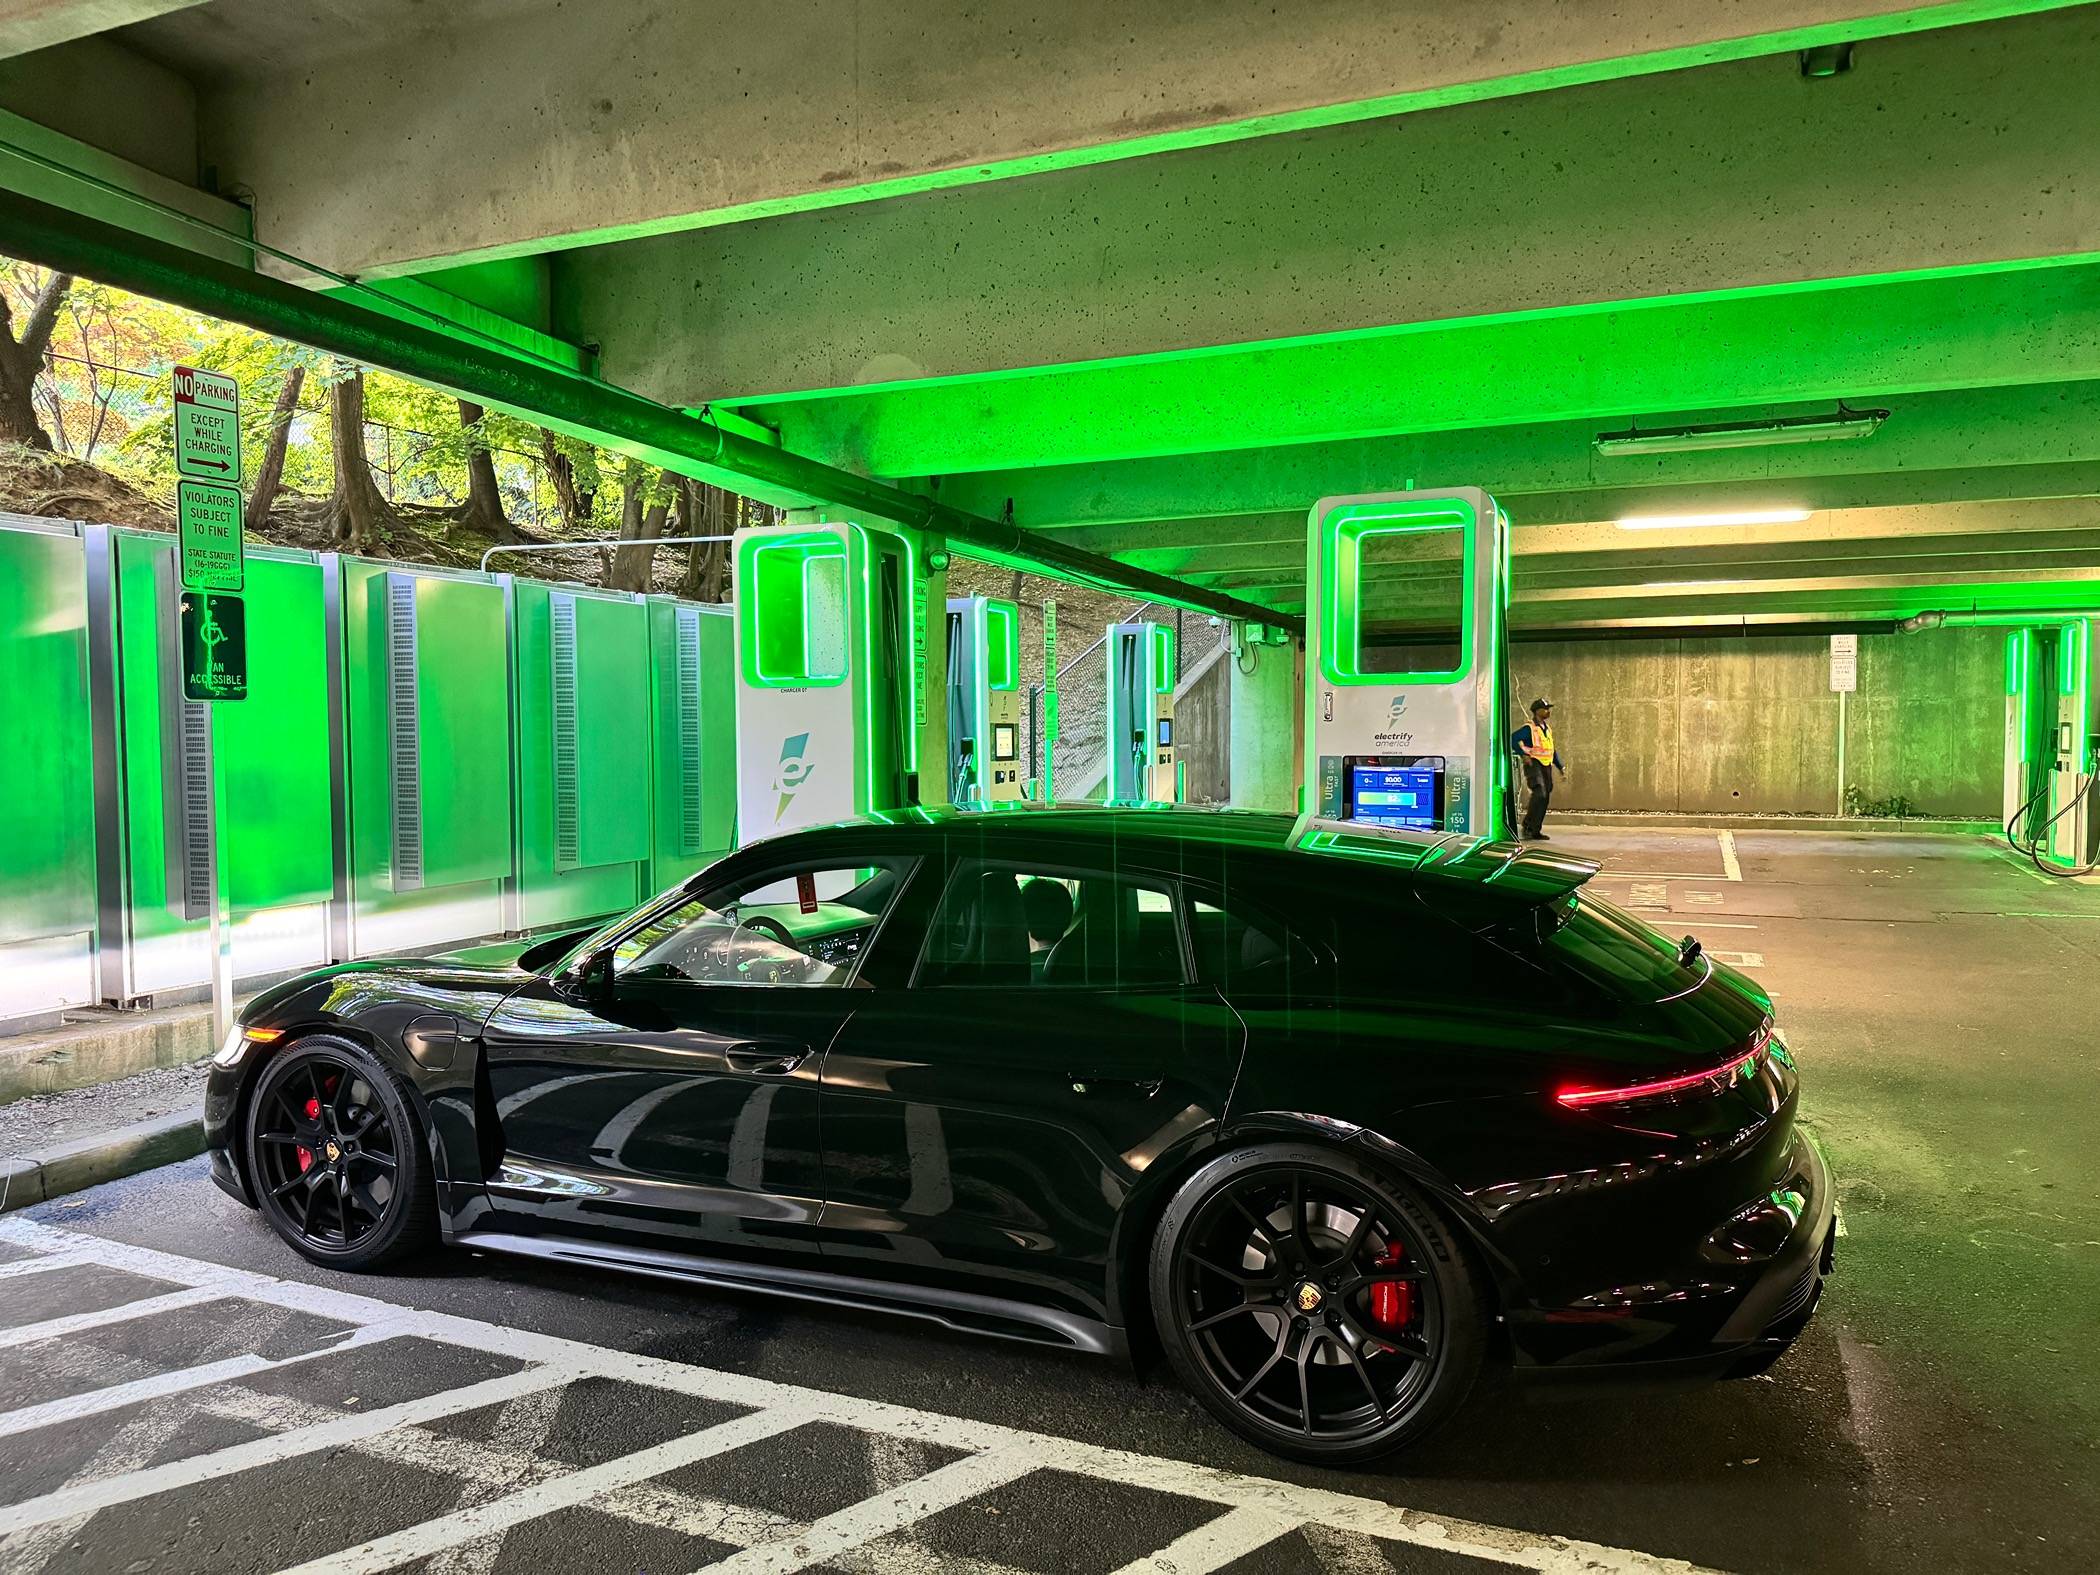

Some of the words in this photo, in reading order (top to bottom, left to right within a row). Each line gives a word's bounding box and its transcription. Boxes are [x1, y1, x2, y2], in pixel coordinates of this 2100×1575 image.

[175, 373, 194, 397] NO
[195, 381, 235, 402] PARKING
[190, 412, 225, 430] EXCEPT
[194, 427, 223, 442] WHILE
[185, 438, 232, 457] CHARGING
[185, 490, 235, 508] VIOLATORS
[190, 507, 231, 523] SUBJECT
[193, 522, 205, 535] TO
[208, 525, 229, 538] FINE
[188, 548, 208, 559] STATE
[209, 550, 236, 562] STATUTE
[190, 673, 242, 685] ACCSSIBLE
[1374, 732, 1413, 741] electrify
[1324, 775, 1334, 800] Ultra
[1450, 777, 1461, 802] Ultra
[1450, 816, 1465, 824] 150
